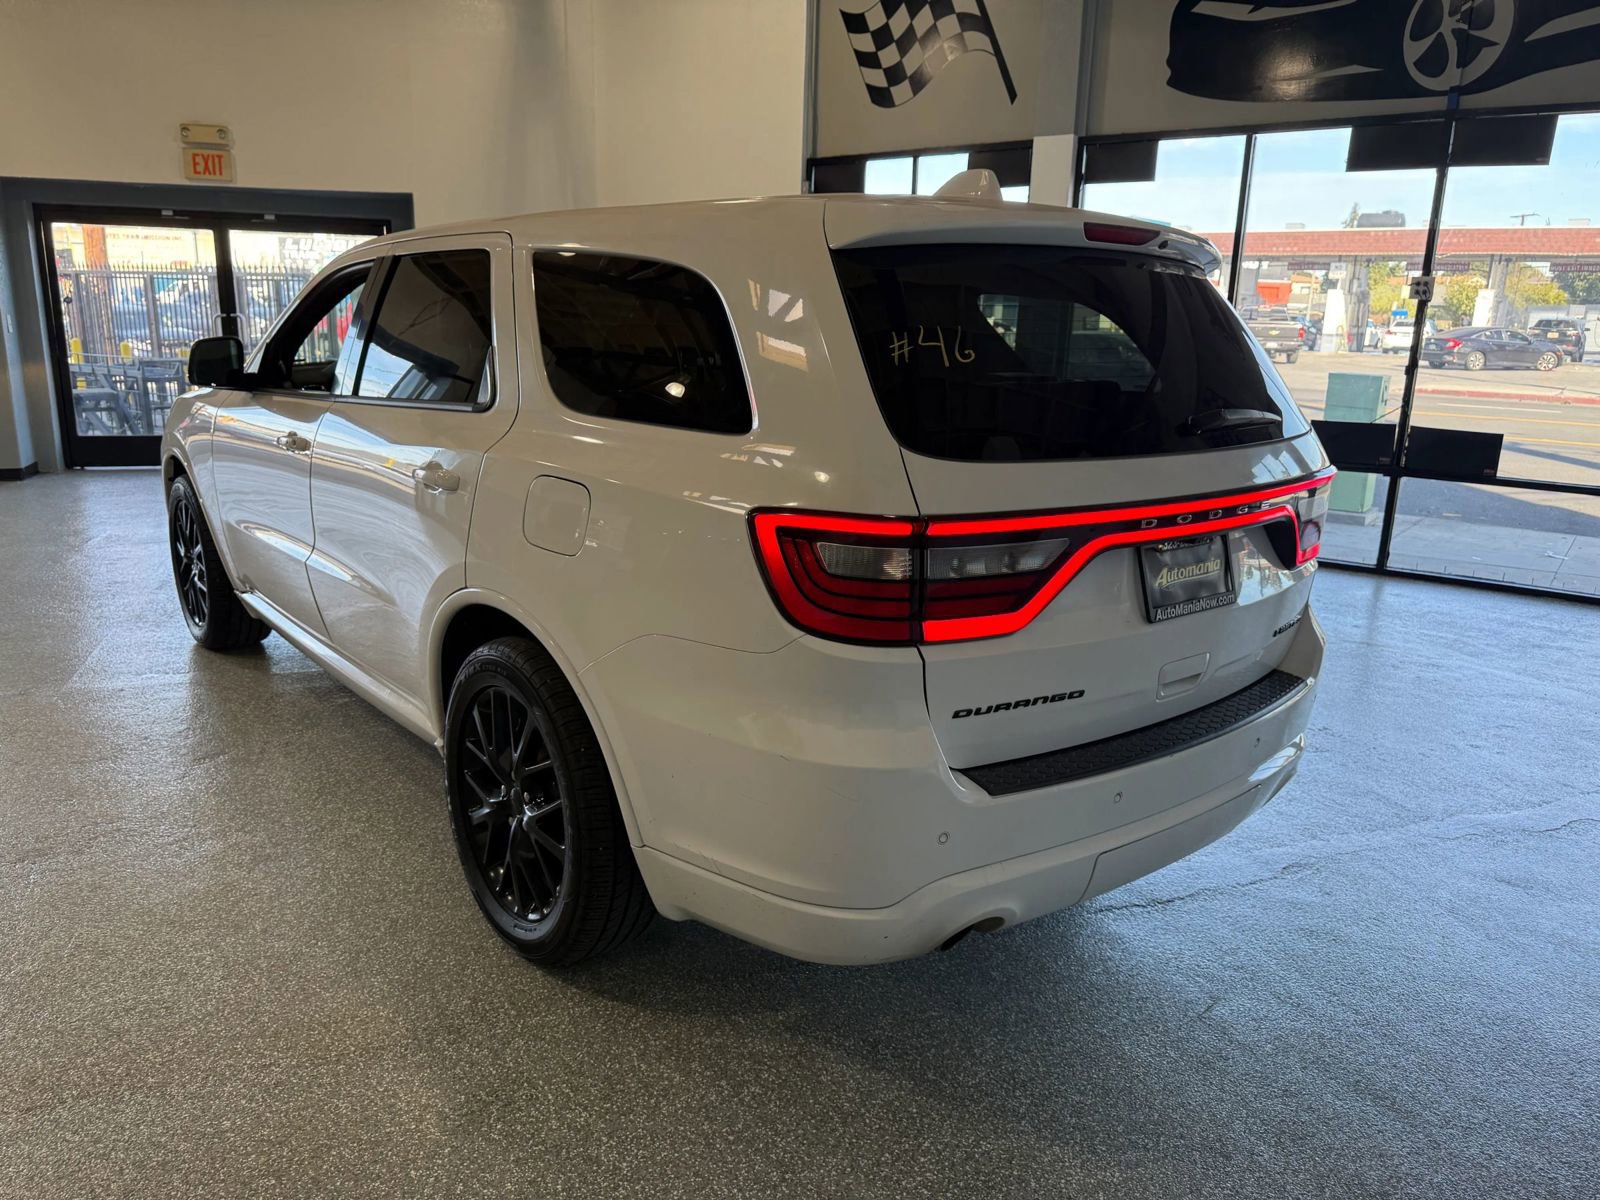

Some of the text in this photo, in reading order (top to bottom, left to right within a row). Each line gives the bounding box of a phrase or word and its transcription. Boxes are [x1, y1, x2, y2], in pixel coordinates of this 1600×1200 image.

[191, 152, 224, 176] EXIT
[889, 325, 975, 367] #46
[1140, 501, 1272, 529] DODGE
[1155, 558, 1222, 588] Automania
[1156, 594, 1235, 621] AutoManiaNow.com
[951, 689, 1086, 719] DURANGO
